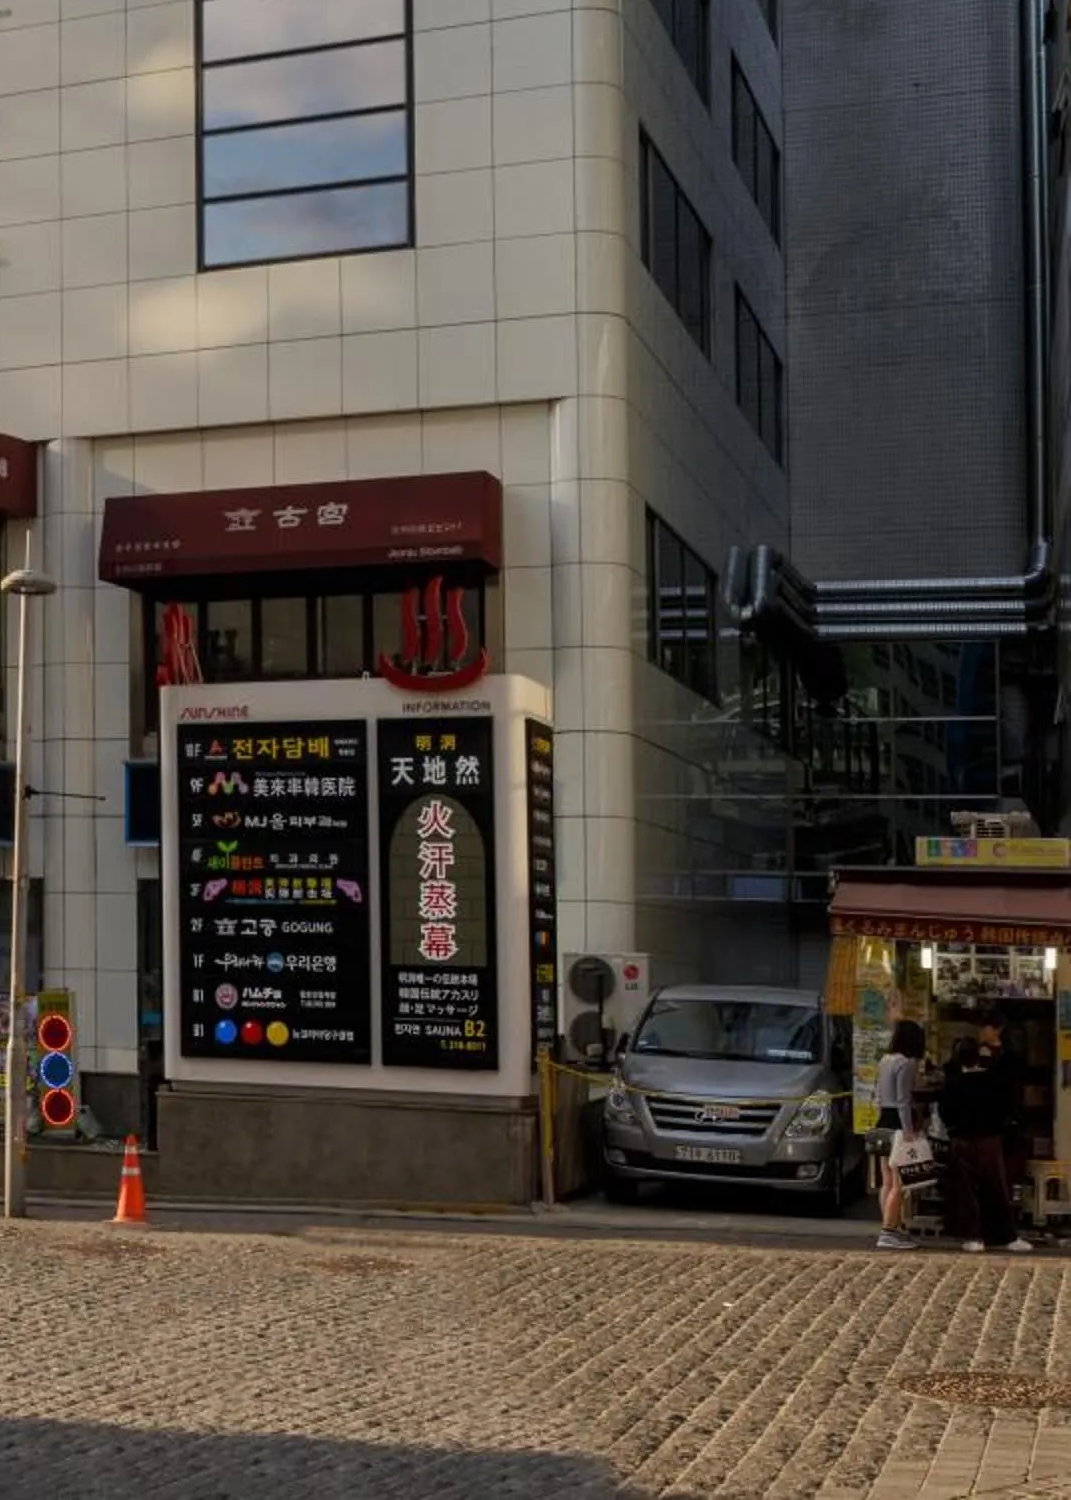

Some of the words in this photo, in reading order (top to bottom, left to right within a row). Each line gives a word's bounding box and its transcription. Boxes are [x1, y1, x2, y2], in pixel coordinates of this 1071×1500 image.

[181, 706, 249, 719] SUNSHINE
[402, 700, 491, 713] INFORMATION
[232, 737, 331, 760] 전자담배
[389, 755, 481, 786] 天地然
[418, 801, 458, 962] 火汗蒸幕
[240, 919, 279, 938] 고궁
[281, 920, 335, 934] GOGUNG
[285, 955, 338, 973] 우리은행
[424, 1023, 463, 1037] SAUNA
[464, 1018, 486, 1038] B2
